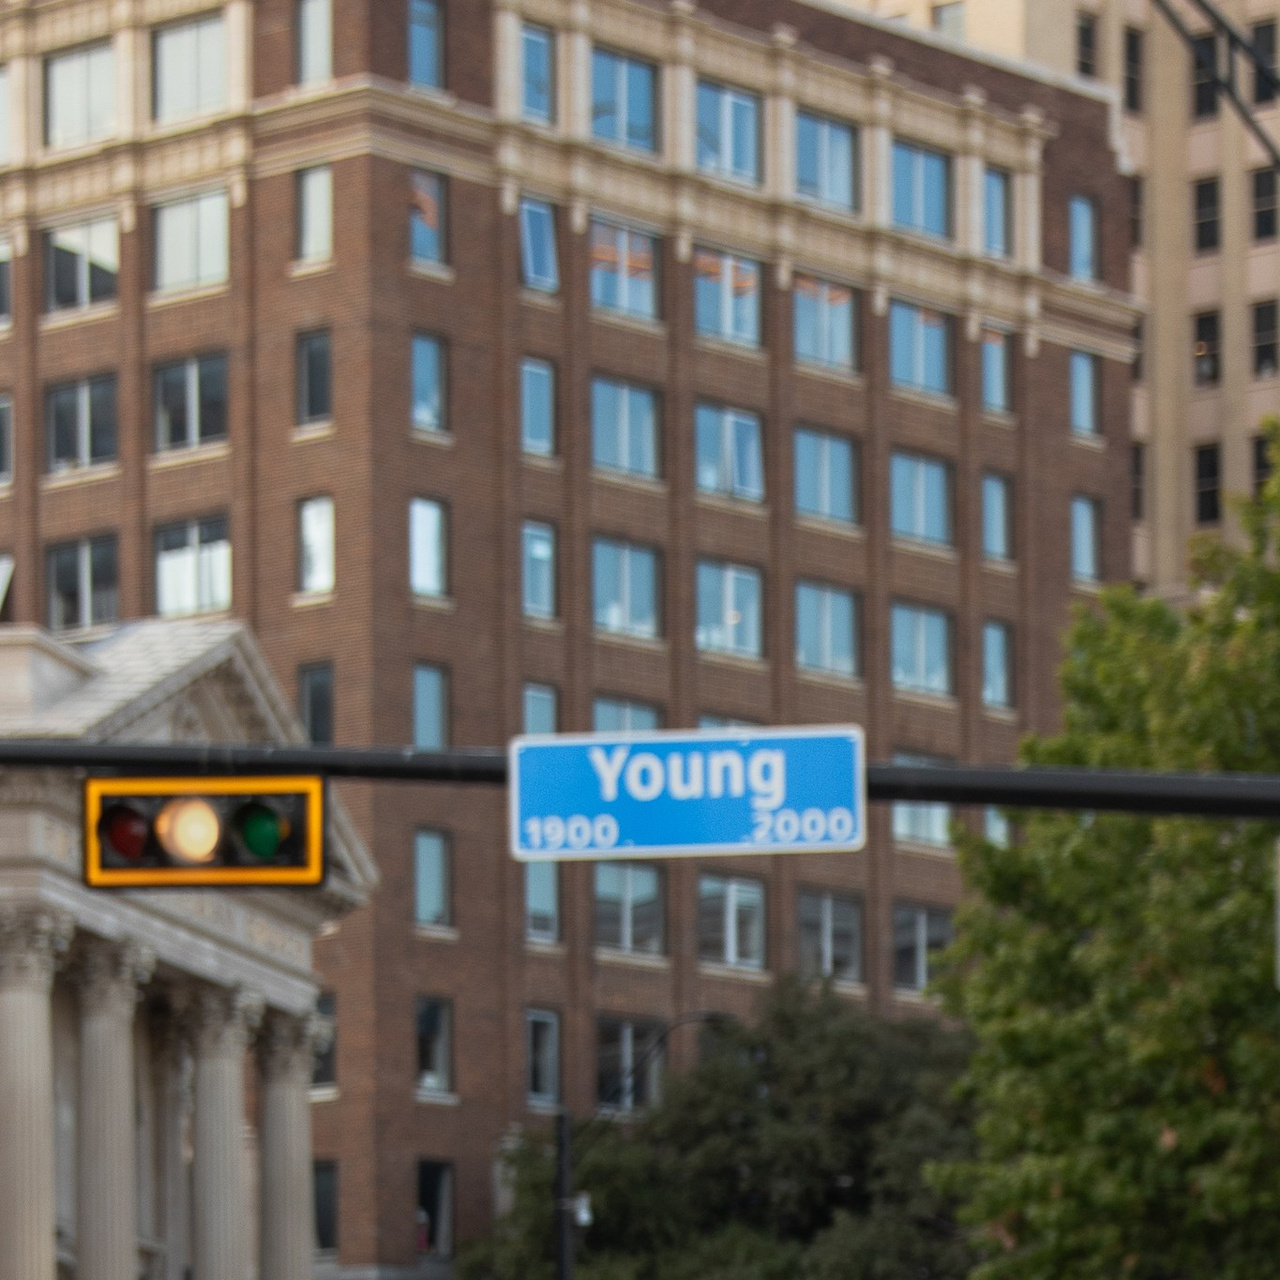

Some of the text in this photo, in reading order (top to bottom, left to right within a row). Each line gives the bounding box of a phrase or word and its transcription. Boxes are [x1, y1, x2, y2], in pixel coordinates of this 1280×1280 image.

[590, 746, 785, 810] Young
[525, 815, 619, 850] 1900
[752, 806, 853, 843] 2000
